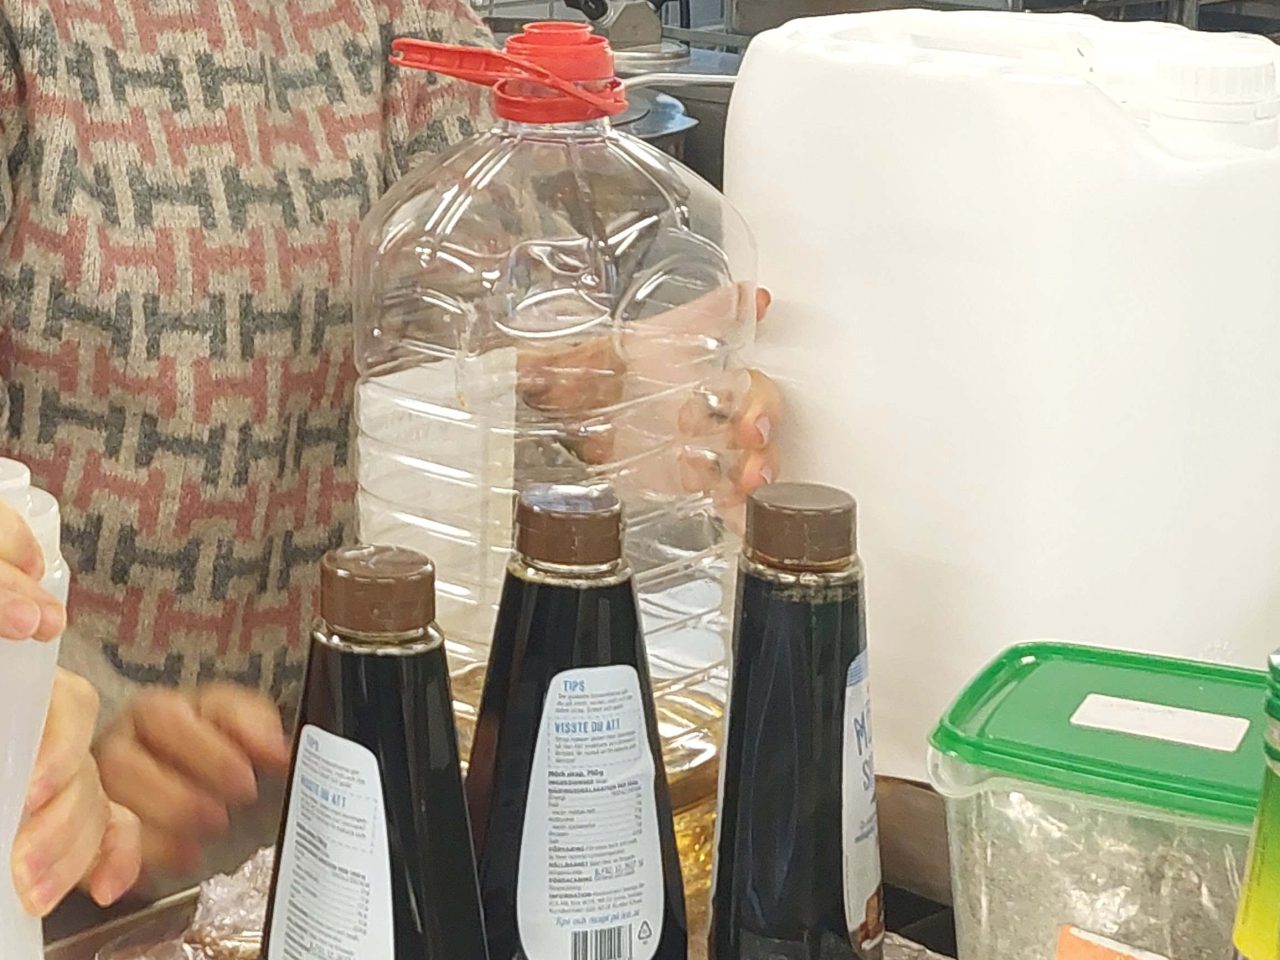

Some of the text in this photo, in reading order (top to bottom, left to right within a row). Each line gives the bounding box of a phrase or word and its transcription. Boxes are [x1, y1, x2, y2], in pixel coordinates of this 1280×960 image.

[563, 679, 586, 692] TIPS
[554, 718, 621, 734] VISSTE DU ATT
